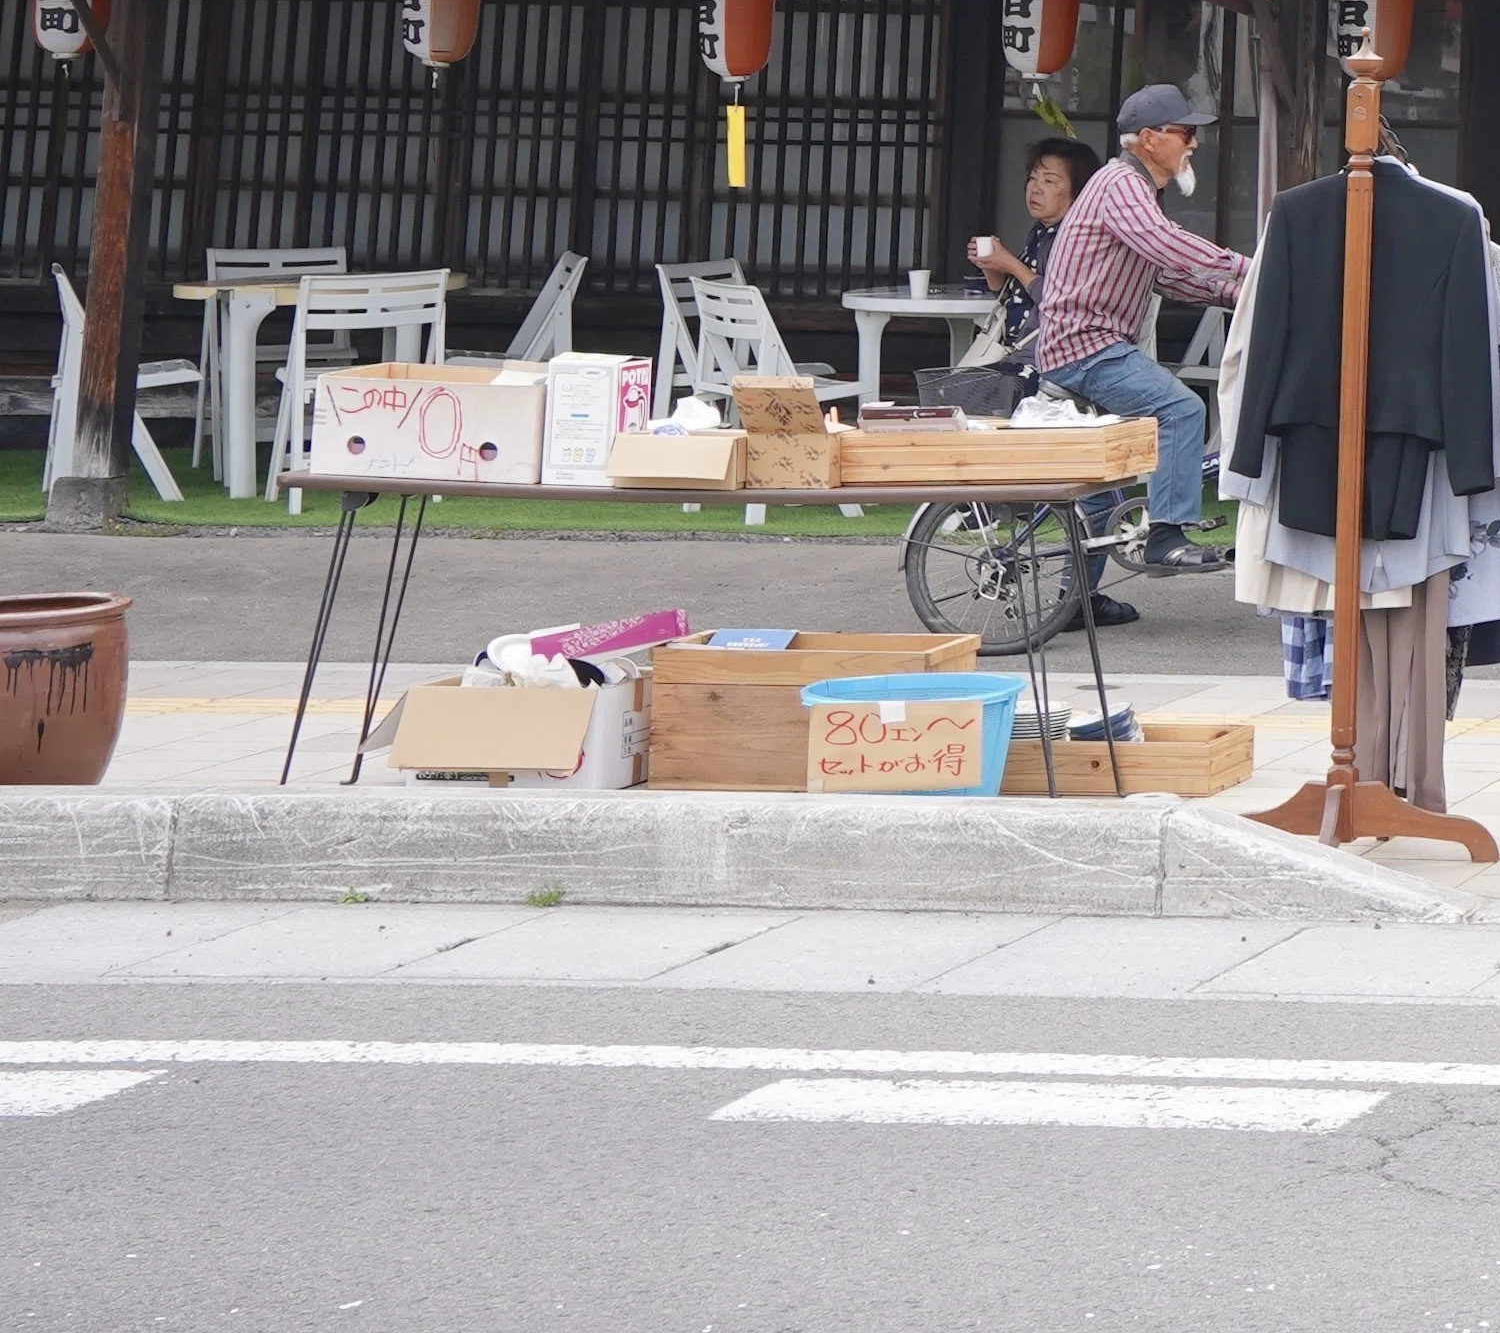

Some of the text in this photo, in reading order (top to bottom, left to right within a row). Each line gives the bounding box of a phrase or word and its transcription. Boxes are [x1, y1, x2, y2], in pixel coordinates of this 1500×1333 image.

[340, 385, 407, 414] この中
[817, 743, 967, 777] セットがお得
